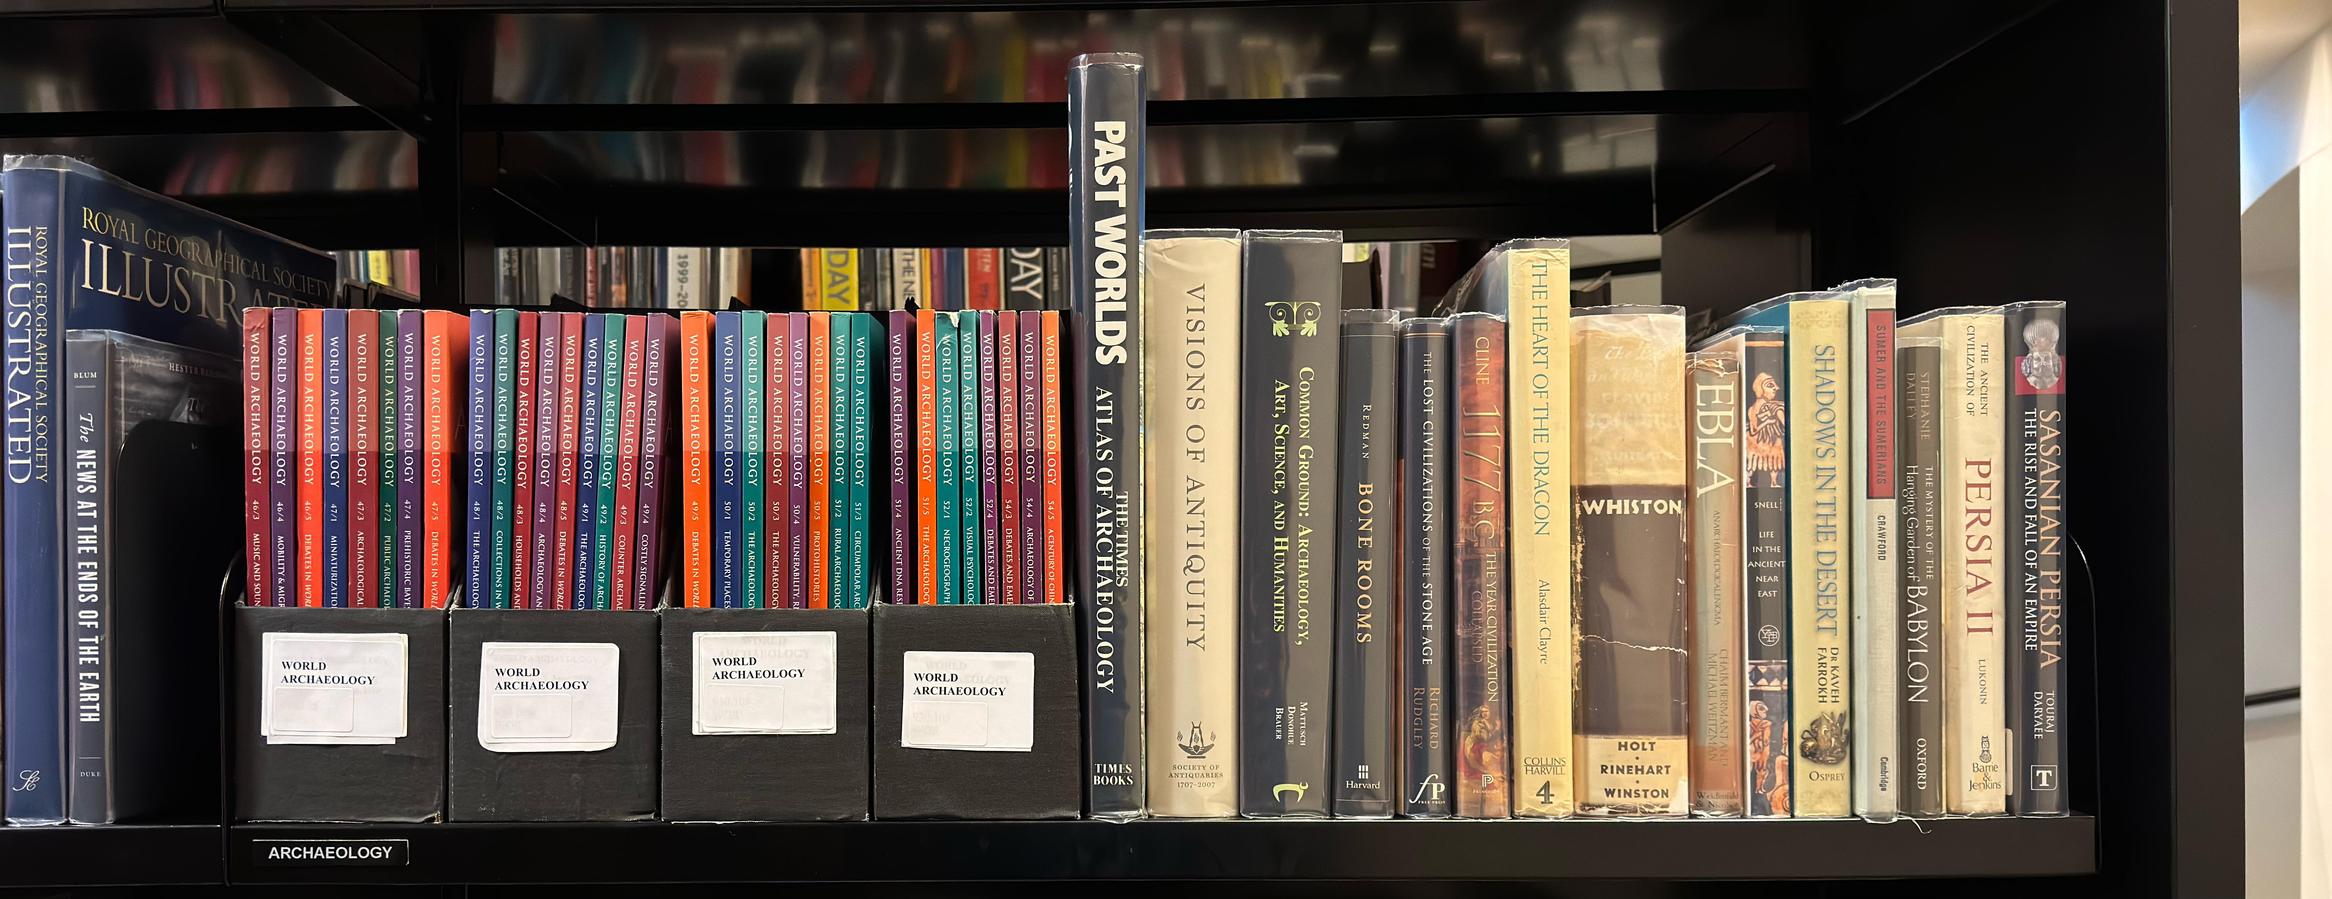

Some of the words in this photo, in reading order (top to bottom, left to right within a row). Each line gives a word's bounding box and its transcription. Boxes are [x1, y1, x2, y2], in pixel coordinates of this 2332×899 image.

[1094, 120, 1127, 208] PAST
[34, 226, 48, 278] ROYAL
[82, 206, 140, 245] ROYAL
[144, 228, 270, 282] GEOGRAPHICAL
[274, 268, 333, 300] SOCIETY
[1094, 214, 1128, 367] WORLDS
[1532, 260, 1548, 300] THE
[7, 226, 33, 485] ILLUSTRATED
[34, 282, 48, 410] GEOGRAPHICAL
[250, 332, 260, 381] WORLD
[1186, 284, 1206, 410] VISIONS
[1532, 305, 1549, 370] HEART
[1876, 324, 1886, 368] SUMER
[1980, 342, 1989, 364] THE
[607, 338, 618, 387] WORLD
[814, 336, 824, 384] WORLD
[892, 334, 902, 382] WORLD
[1423, 352, 1432, 374] THE
[1475, 336, 1490, 386] CLINE
[1966, 326, 1976, 396] CIVILIZATION
[1423, 379, 1434, 416] LOST
[1532, 374, 1549, 400] OF
[1876, 368, 1886, 390] AND
[1906, 372, 1916, 420] DALLEY
[1980, 370, 1990, 416] ANCIENT
[1299, 366, 1315, 439] COMMON
[1814, 344, 1836, 458] SHADOWS
[1876, 394, 1886, 416] THE
[1920, 371, 1930, 440] STEPHANIE
[1966, 402, 1976, 417] OF
[79, 412, 95, 444] The
[250, 386, 262, 484] ARCHAEOLOGY
[603, 391, 614, 490] ARCHAEOLOGY
[814, 388, 824, 485] ARCHAEOLOGY
[893, 386, 904, 484] ARCHAEOLOGY
[1095, 386, 1114, 462] ATLAS
[1362, 404, 1372, 460] REDMAN
[1532, 403, 1550, 444] THE
[1696, 381, 1736, 498] EBLA
[2024, 408, 2037, 438] THE
[34, 415, 48, 482] SOCIETY
[1186, 424, 1206, 464] OF
[1463, 405, 1501, 492] 1177
[1876, 420, 1888, 485] SUMERIANS
[2024, 443, 2037, 472] RISE
[76, 450, 97, 494] NEWS
[1095, 467, 1114, 500] OF
[1422, 420, 1434, 532] CIVILIZATIONS
[1816, 467, 1836, 494] IN
[1902, 465, 1918, 514] Hanging
[1924, 466, 1934, 486] THE
[2040, 410, 2061, 556] SASANIAN
[77, 501, 97, 518] AT
[252, 500, 260, 520] 46/3
[1116, 491, 1130, 529] THE
[1533, 451, 1551, 536] DRAGON
[1582, 499, 1682, 516] WHISTON
[1925, 490, 1934, 532] MYSTERY
[2024, 476, 2037, 510] AND
[600, 504, 608, 524] 49/2
[1274, 500, 1286, 531] AND
[1358, 482, 1374, 550] BONE
[1816, 498, 1837, 543] THE
[1965, 458, 1992, 596] PERSIA
[2025, 514, 2037, 546] FALL
[77, 523, 98, 554] THE
[253, 533, 261, 560] MUSIC
[598, 534, 606, 570] HISTORY
[1422, 538, 1431, 555] OF
[1759, 530, 1774, 538] LIFE
[1876, 515, 1886, 560] CRAWFORD
[1906, 516, 1919, 564] Garden
[1926, 535, 1934, 558] OF
[1116, 532, 1129, 588] TIMES
[1182, 475, 1206, 652] ANTIQUITY
[1422, 558, 1431, 578] THE
[1486, 552, 1496, 578] THE
[1748, 560, 1786, 568] ANCIENT
[1906, 566, 1920, 582] of
[1926, 559, 1934, 580] THE
[2025, 552, 2038, 571] OF
[78, 561, 98, 603] ENDS
[1096, 504, 1115, 694] ARCHAEOLOGY
[1274, 536, 1290, 633] HUMANITIES
[1356, 559, 1372, 644] ROOMS
[1486, 580, 1497, 617] YEAR
[1538, 578, 1550, 624] Alasdair
[1758, 590, 1778, 598] EAST
[1816, 550, 1838, 636] DESERT
[2025, 574, 2038, 594] AN
[78, 608, 98, 629] OF
[1422, 582, 1433, 632] STONE
[1966, 609, 1994, 636] II
[2025, 600, 2038, 651] EMPIRE
[2040, 570, 2062, 670] PERSIA
[78, 636, 100, 666] THE
[712, 656, 758, 667] WORLD
[1422, 636, 1433, 666] AGE
[1486, 616, 1498, 702] CIVILIZATION
[1538, 626, 1552, 665] Clayre
[1907, 586, 1930, 703] BABYLON
[280, 660, 327, 672] WORLD
[280, 674, 376, 686] ARCHAEOLOGY
[494, 666, 540, 678] WORLD
[494, 680, 590, 691] ARCHAEOLOGY
[712, 668, 805, 680] ARCHAEOLOGY
[914, 672, 958, 683] WORLD
[1817, 647, 1827, 704] FARROKH
[1830, 664, 1840, 704] KAVEH
[1978, 659, 1987, 705] LUKONIN
[79, 672, 100, 722] EARTH
[913, 686, 1006, 697] ARCHAEOLOGY
[1413, 687, 1426, 750] RUDGLEY
[1430, 687, 1441, 750] RICHARD
[2034, 691, 2044, 740] DARYAEE
[2046, 690, 2055, 734] TOURAJ
[1524, 756, 1566, 766] COLLINS
[1618, 741, 1656, 752] HOLT
[1916, 738, 1928, 790] OXFORD
[1092, 774, 1134, 787] BOOKS
[1094, 764, 1133, 776] TIMES
[1168, 772, 1224, 780] ANTIQUARIES
[1172, 764, 1207, 772] SOCIETY
[1209, 764, 1220, 772] OF
[1346, 780, 1380, 790] Harvard
[1524, 766, 1566, 776] HARVILL
[1600, 764, 1671, 775] RINEHART
[1809, 771, 1845, 782] OSPREY
[1880, 756, 1888, 792] Cambridge
[1968, 780, 2002, 792] Jenkins
[1972, 762, 1998, 773] Barrie
[1983, 772, 1992, 782] &
[2036, 772, 2052, 786] T
[1536, 780, 1554, 804] 4
[1604, 788, 1670, 798] WINSTON
[268, 846, 392, 860] ARCHAEOLOGY
